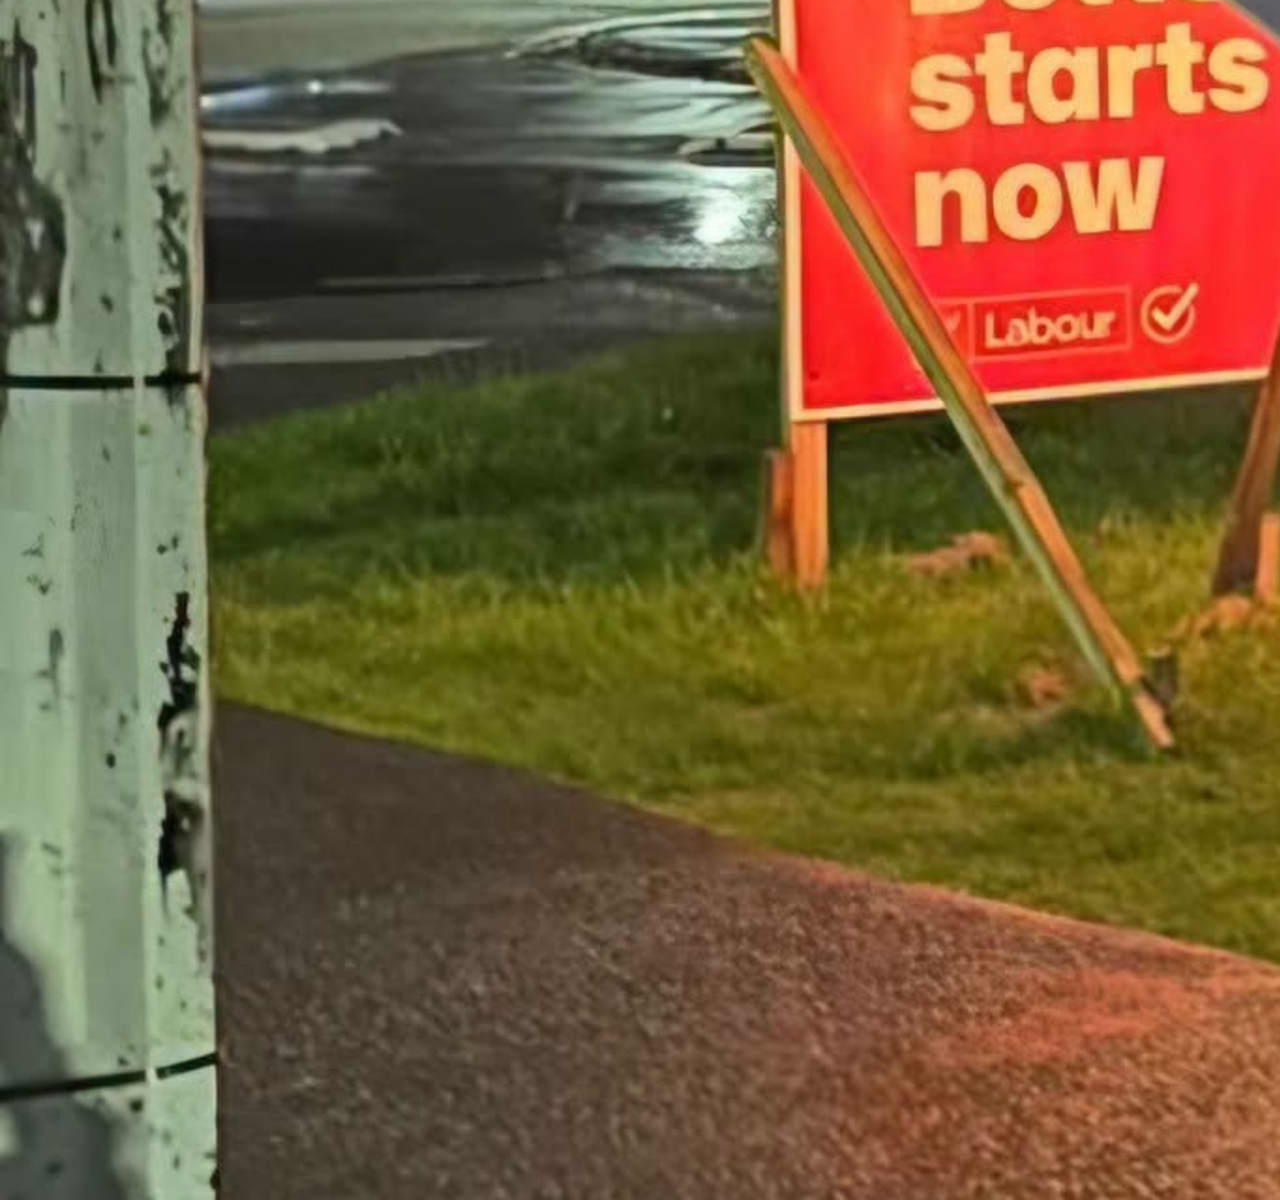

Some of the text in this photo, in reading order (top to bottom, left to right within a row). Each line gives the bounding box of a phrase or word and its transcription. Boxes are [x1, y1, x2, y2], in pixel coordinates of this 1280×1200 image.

[909, 22, 1269, 132] starts
[914, 155, 1166, 247] now
[985, 306, 1116, 349] Labour
